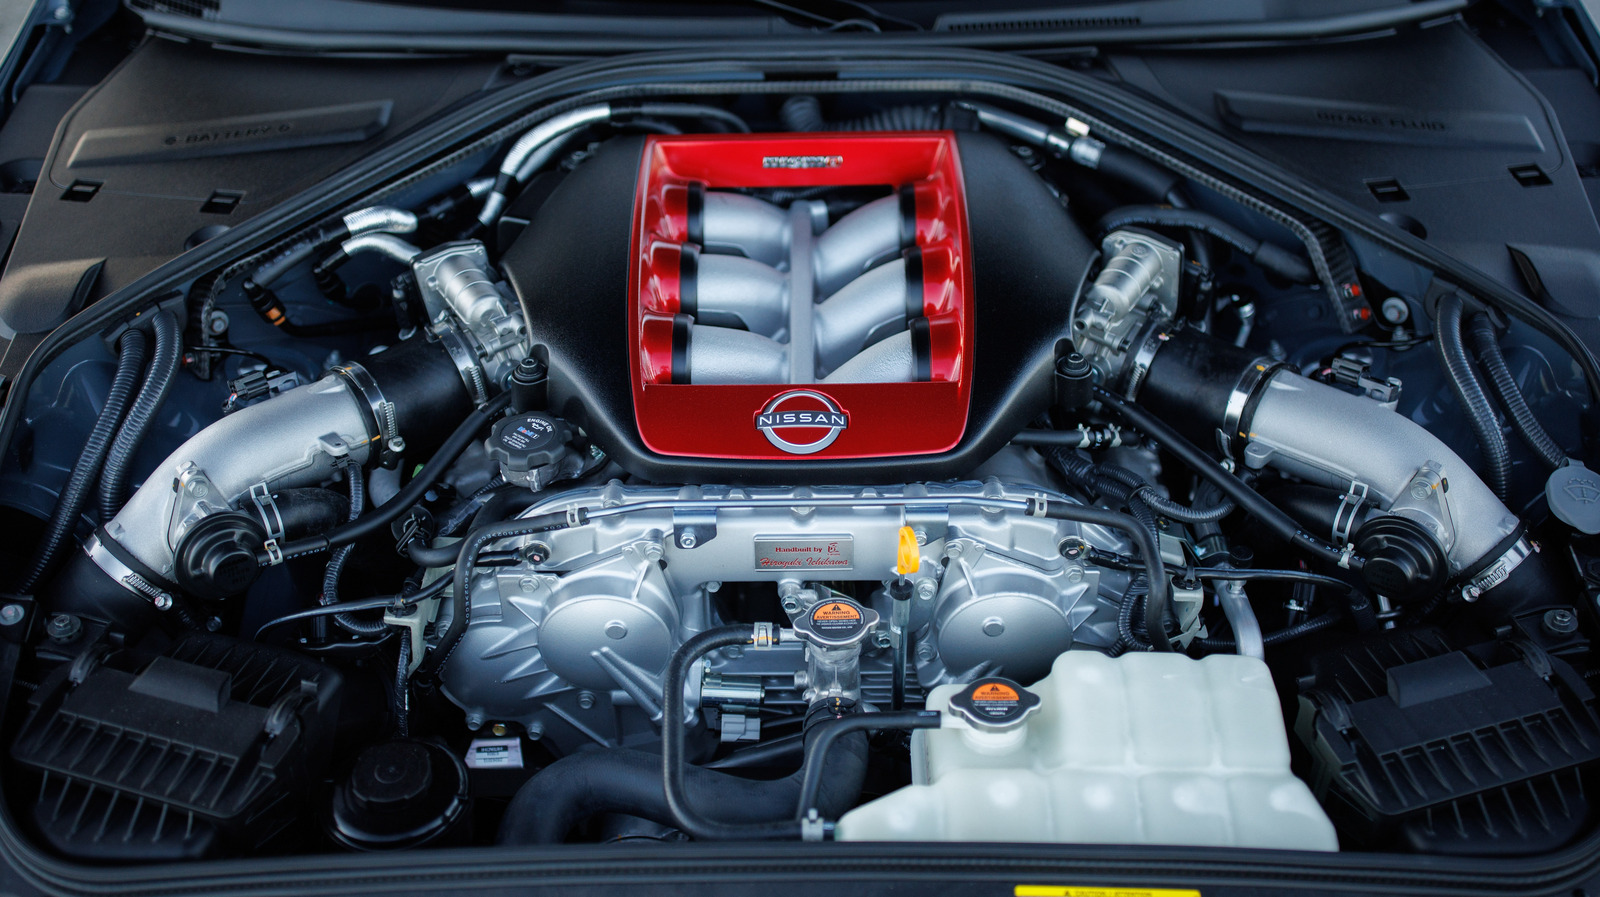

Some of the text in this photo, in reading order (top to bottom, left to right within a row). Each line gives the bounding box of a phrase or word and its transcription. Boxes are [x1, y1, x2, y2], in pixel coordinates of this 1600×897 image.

[1389, 118, 1446, 131] FLUID
[185, 126, 272, 144] BATTERY
[527, 418, 549, 427] ENGINE
[759, 413, 845, 425] NISSAN
[759, 556, 849, 568] Hiroyuki Ichikawa
